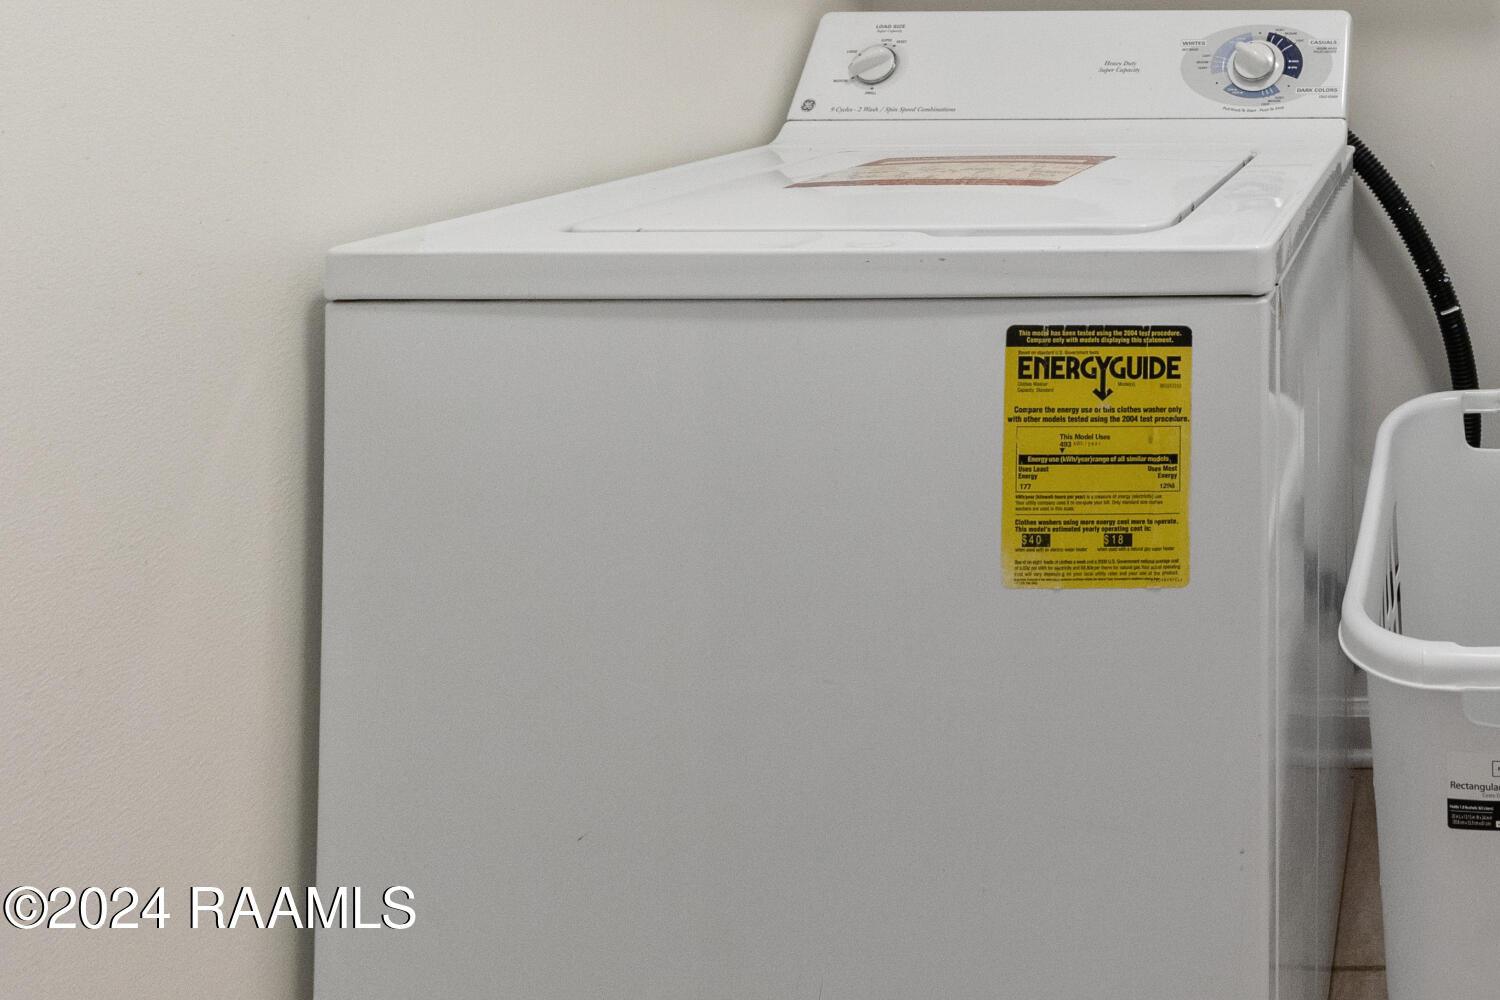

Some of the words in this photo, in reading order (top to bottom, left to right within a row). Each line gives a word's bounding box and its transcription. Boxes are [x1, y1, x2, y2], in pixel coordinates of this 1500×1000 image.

[1017, 356, 1182, 380] ENERGYGUIDE
[1014, 406, 1042, 414] Compare
[1056, 407, 1079, 415] energy
[1167, 406, 1182, 414] only
[1089, 416, 1108, 424] using
[1157, 472, 1177, 480] Energy
[1021, 534, 1042, 545] $40
[1103, 534, 1124, 545] $18
